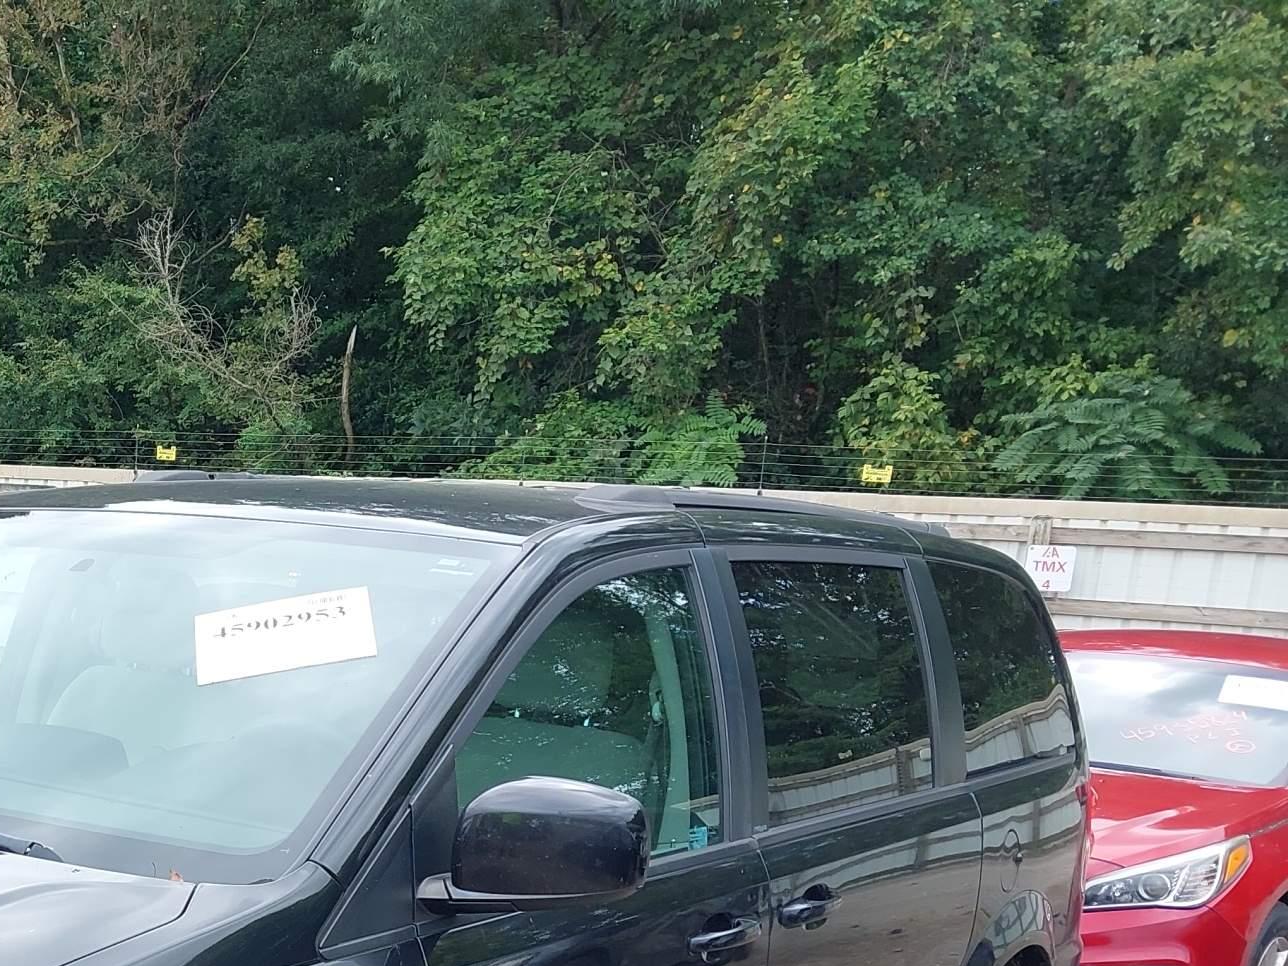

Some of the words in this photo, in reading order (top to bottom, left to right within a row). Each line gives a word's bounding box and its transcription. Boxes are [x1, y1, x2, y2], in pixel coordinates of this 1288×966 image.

[1032, 560, 1068, 573] TMX
[1041, 579, 1050, 589] 4
[212, 605, 348, 639] 45902953
